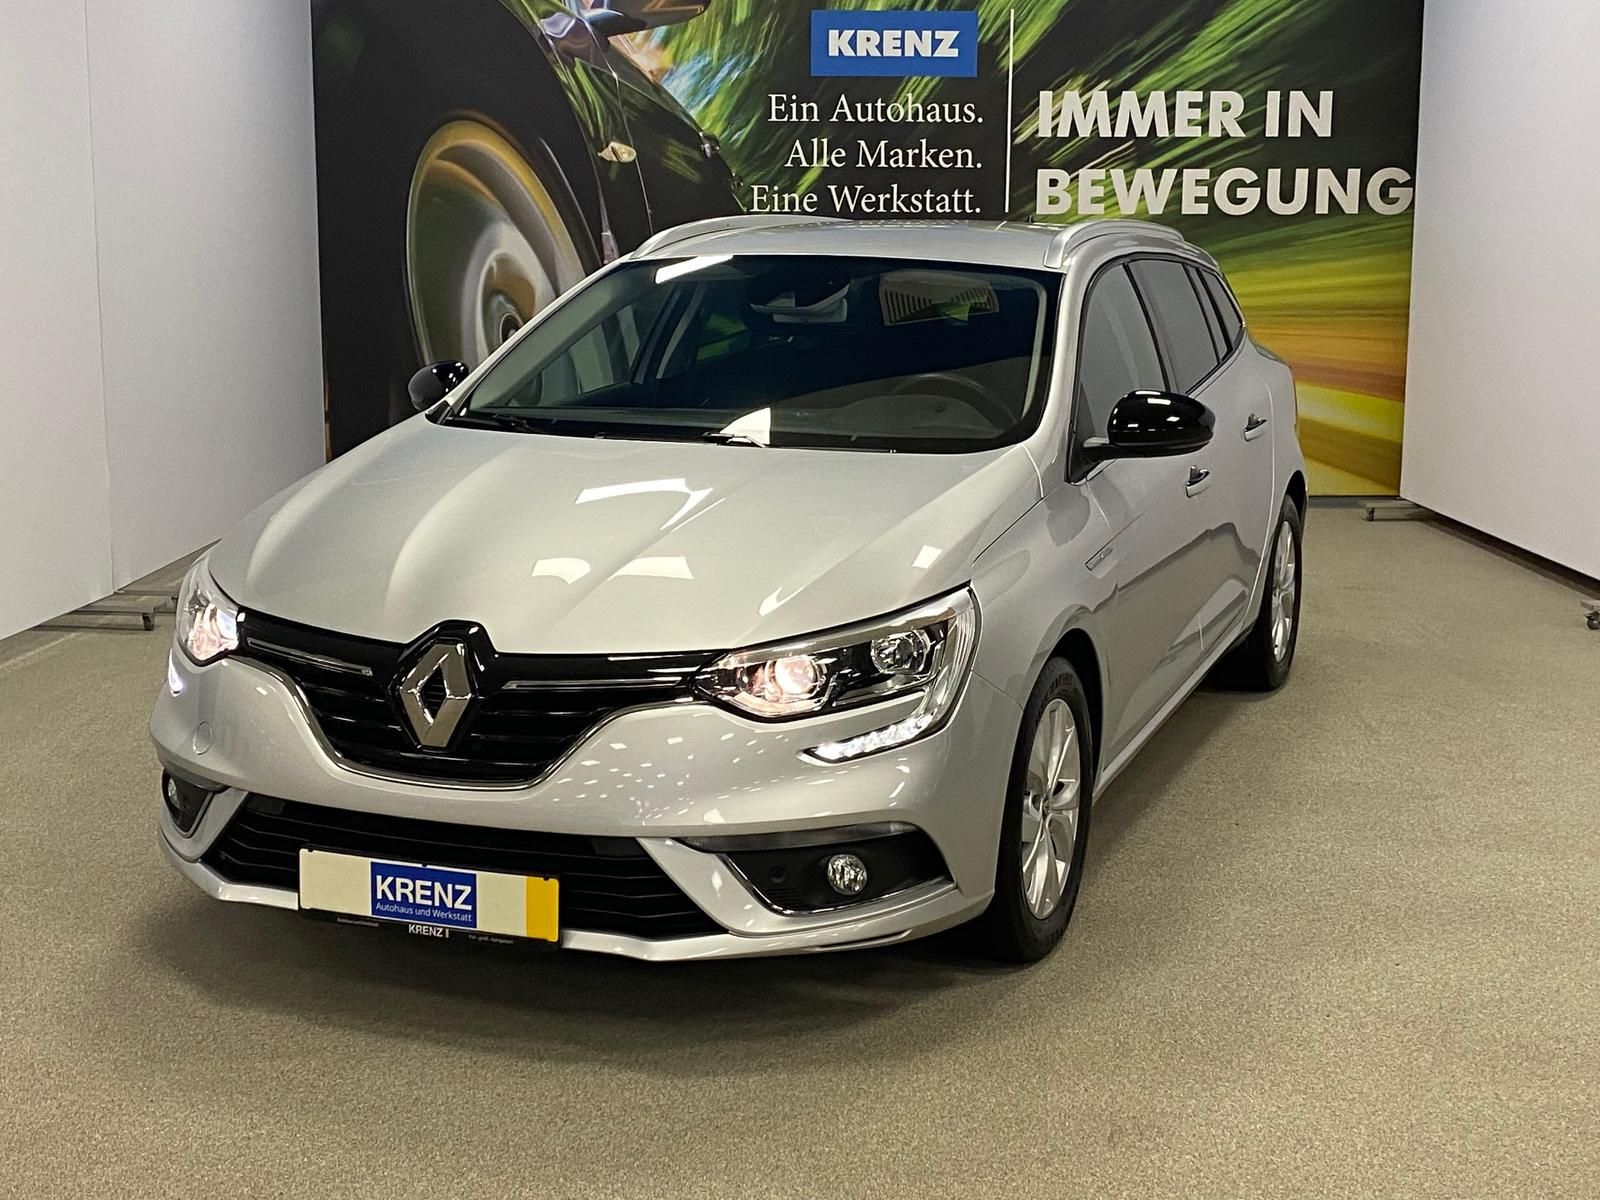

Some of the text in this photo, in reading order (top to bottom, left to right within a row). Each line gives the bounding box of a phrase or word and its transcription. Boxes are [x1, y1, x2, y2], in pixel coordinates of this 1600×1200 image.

[828, 29, 960, 57] KRENZ
[767, 94, 984, 123] Ein Autohaus.
[1038, 90, 1334, 138] IMMER IN
[784, 138, 982, 168] Alle Marken.
[750, 184, 981, 213] Eine Werkstatt.
[1035, 167, 1414, 216] BEWEGUNG
[376, 875, 472, 911] KRENZ
[376, 902, 472, 922] Autohaus und Werkstatt
[408, 924, 443, 937] KRENZ
